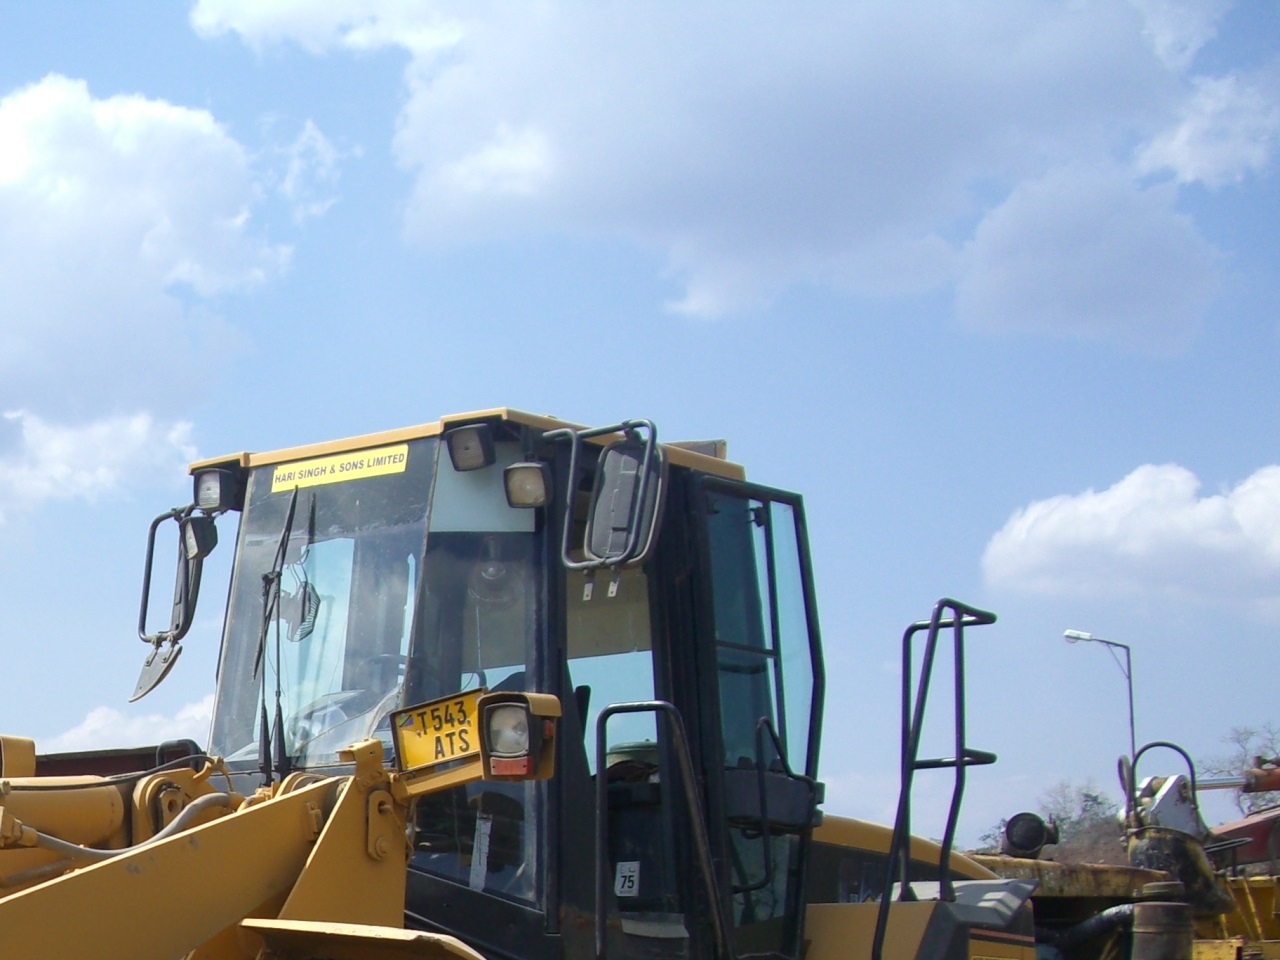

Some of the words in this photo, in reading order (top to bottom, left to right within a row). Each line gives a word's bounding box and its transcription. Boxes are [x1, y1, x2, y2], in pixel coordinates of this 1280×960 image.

[275, 471, 295, 484] HARI
[298, 466, 327, 480] SINGH
[329, 464, 336, 474] &
[339, 459, 365, 473] SONS
[367, 453, 405, 468] LIMITED
[416, 700, 467, 736] T543
[434, 729, 470, 760] ATS
[620, 875, 635, 889] 75
